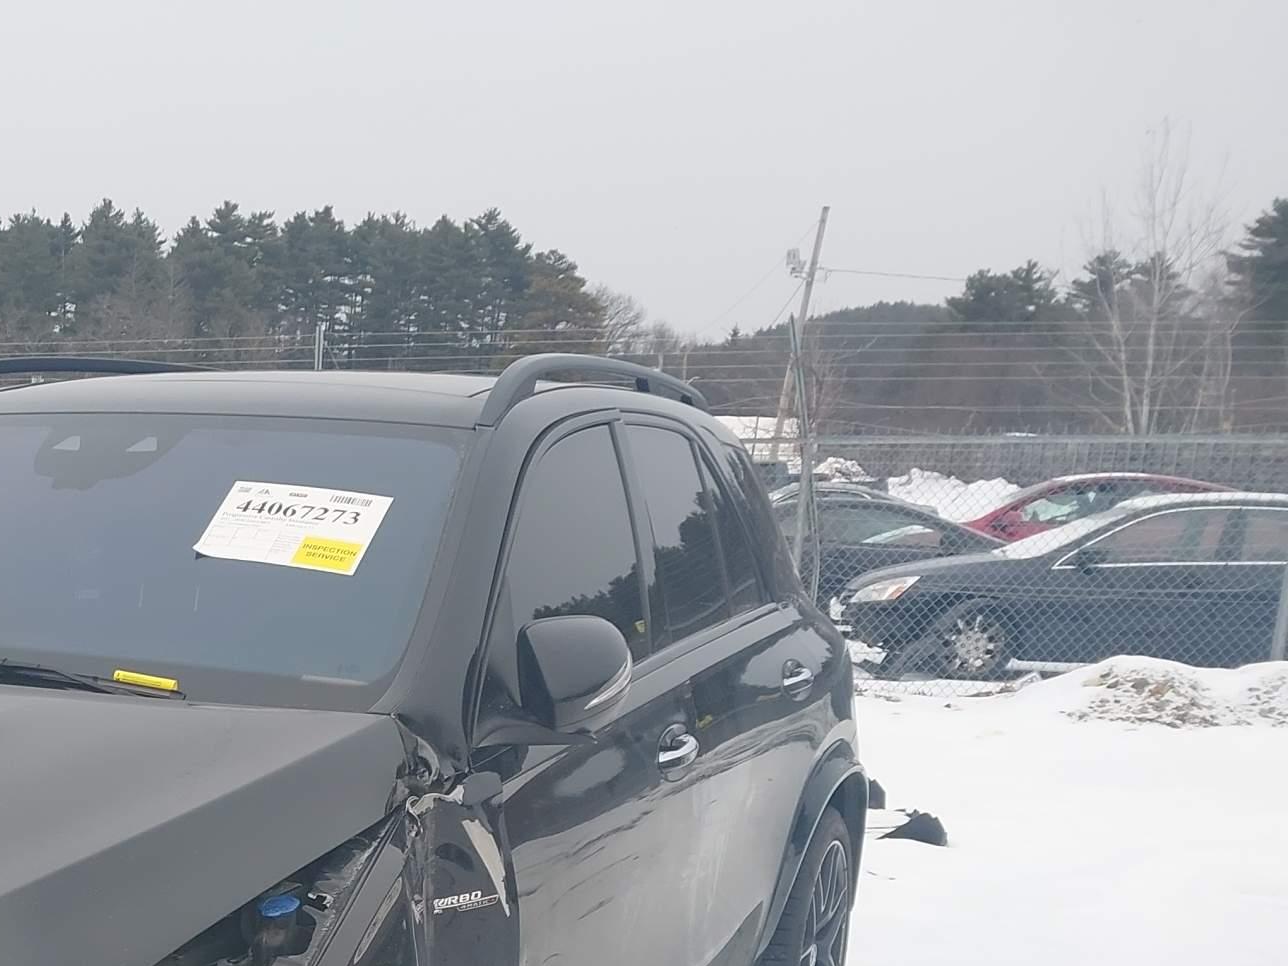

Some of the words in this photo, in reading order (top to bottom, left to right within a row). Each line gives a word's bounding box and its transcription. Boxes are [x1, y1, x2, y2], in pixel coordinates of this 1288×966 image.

[235, 499, 361, 526] 44067273
[302, 543, 358, 556] INSPECTION
[305, 551, 346, 562] SERVICE
